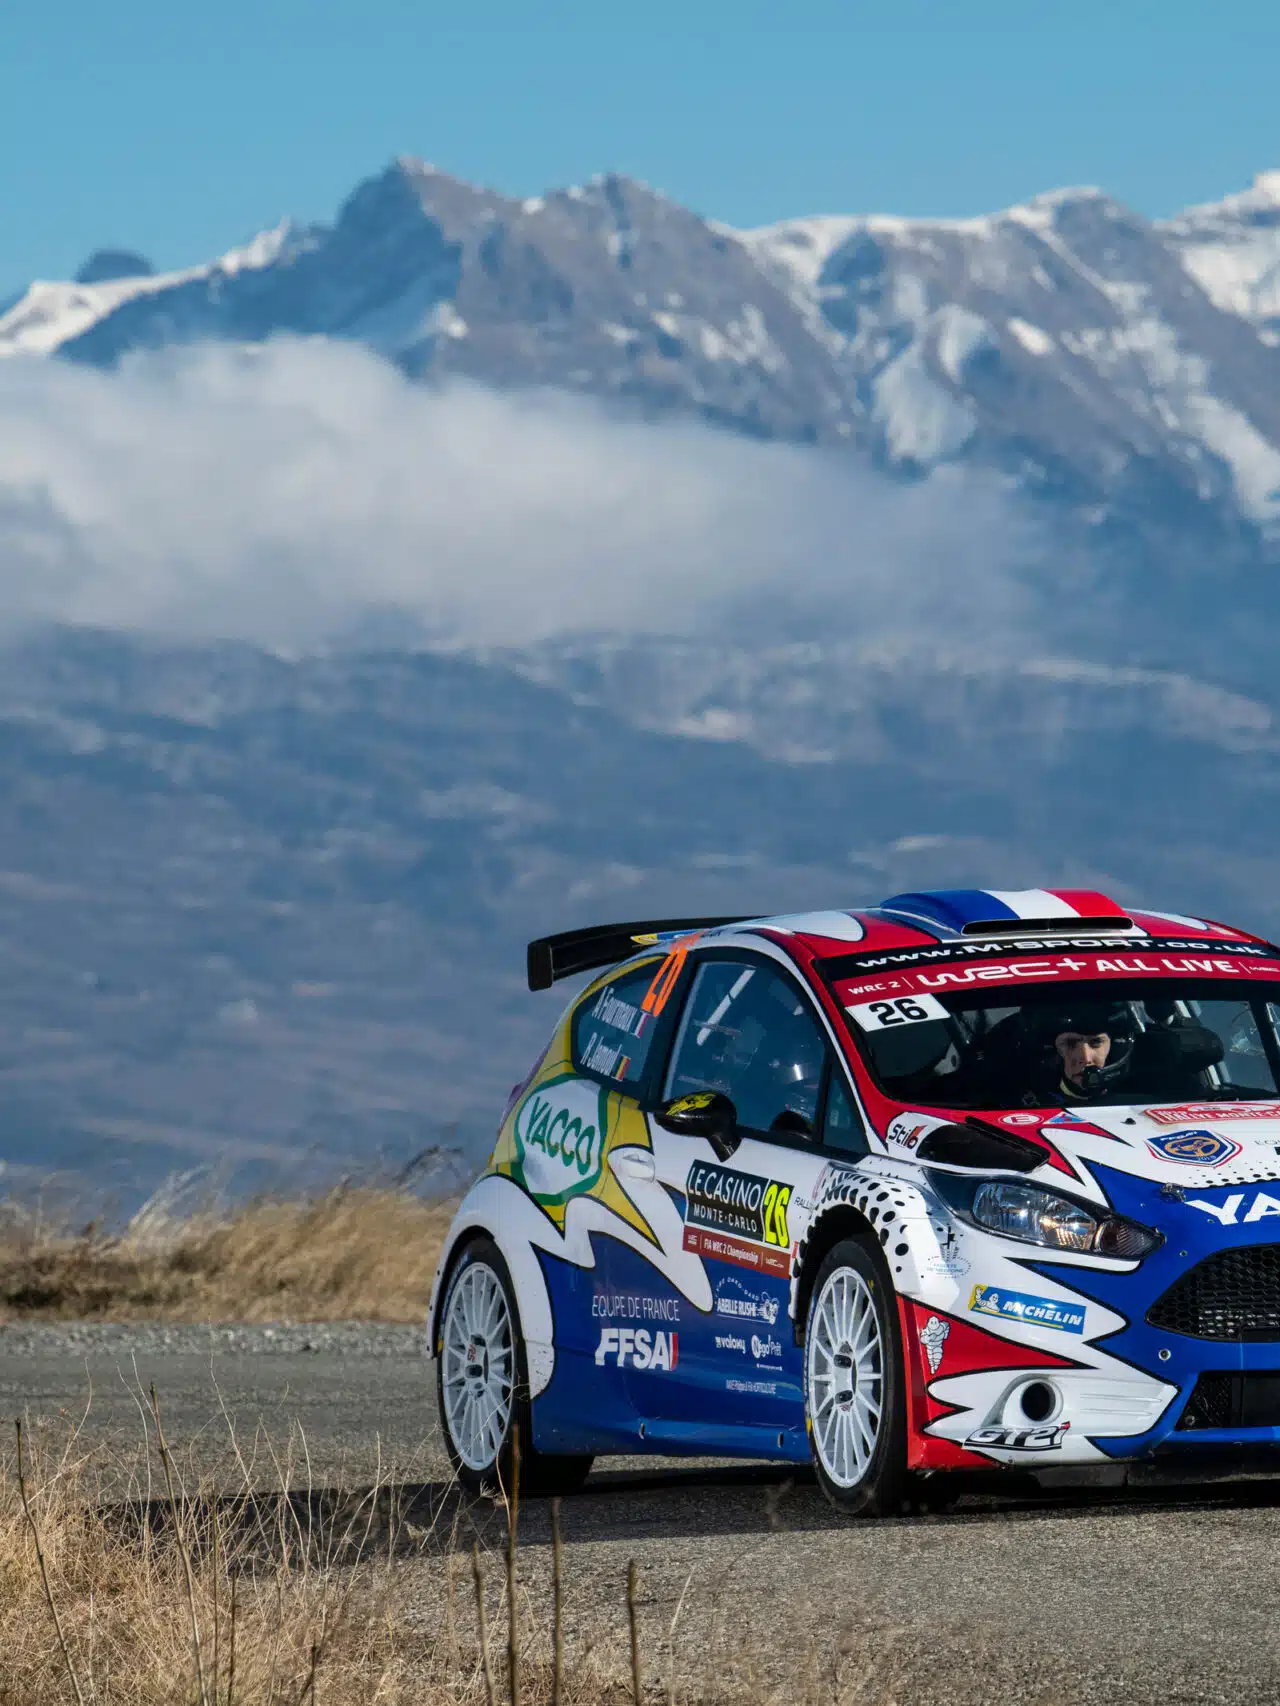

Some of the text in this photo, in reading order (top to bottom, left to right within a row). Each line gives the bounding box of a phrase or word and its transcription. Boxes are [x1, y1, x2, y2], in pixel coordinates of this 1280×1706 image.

[1095, 959, 1240, 974] ALL LIVE
[848, 981, 901, 995] WRC 2
[868, 998, 929, 1026] 26
[526, 1096, 595, 1176] YACCO
[763, 1183, 790, 1248] 26
[592, 1295, 680, 1321] EQUIPE DE FRANCE
[1002, 1300, 1083, 1326] MICHELIN
